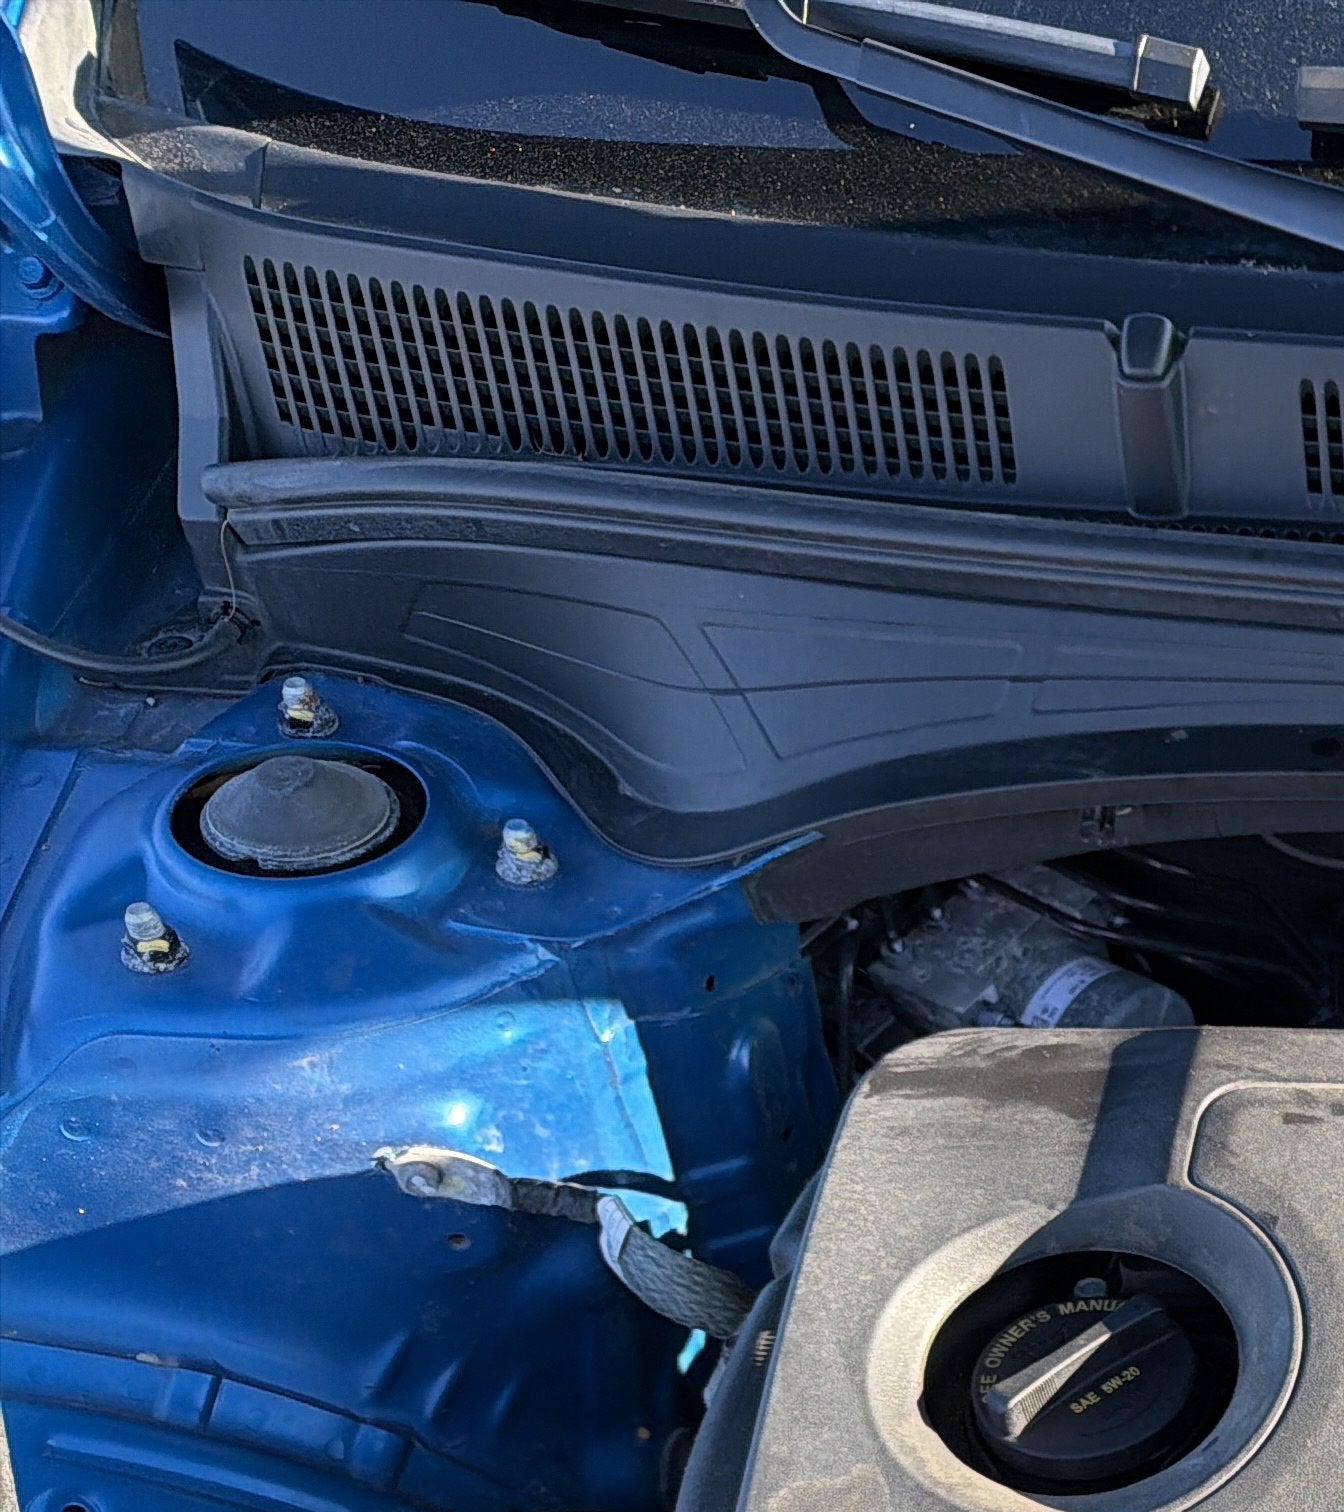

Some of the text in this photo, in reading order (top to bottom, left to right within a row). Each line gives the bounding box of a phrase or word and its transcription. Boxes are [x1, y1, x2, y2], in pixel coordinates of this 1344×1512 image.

[985, 1299, 1123, 1368] OWNER'S MANU
[1068, 1366, 1141, 1415] SAE 5W-20
